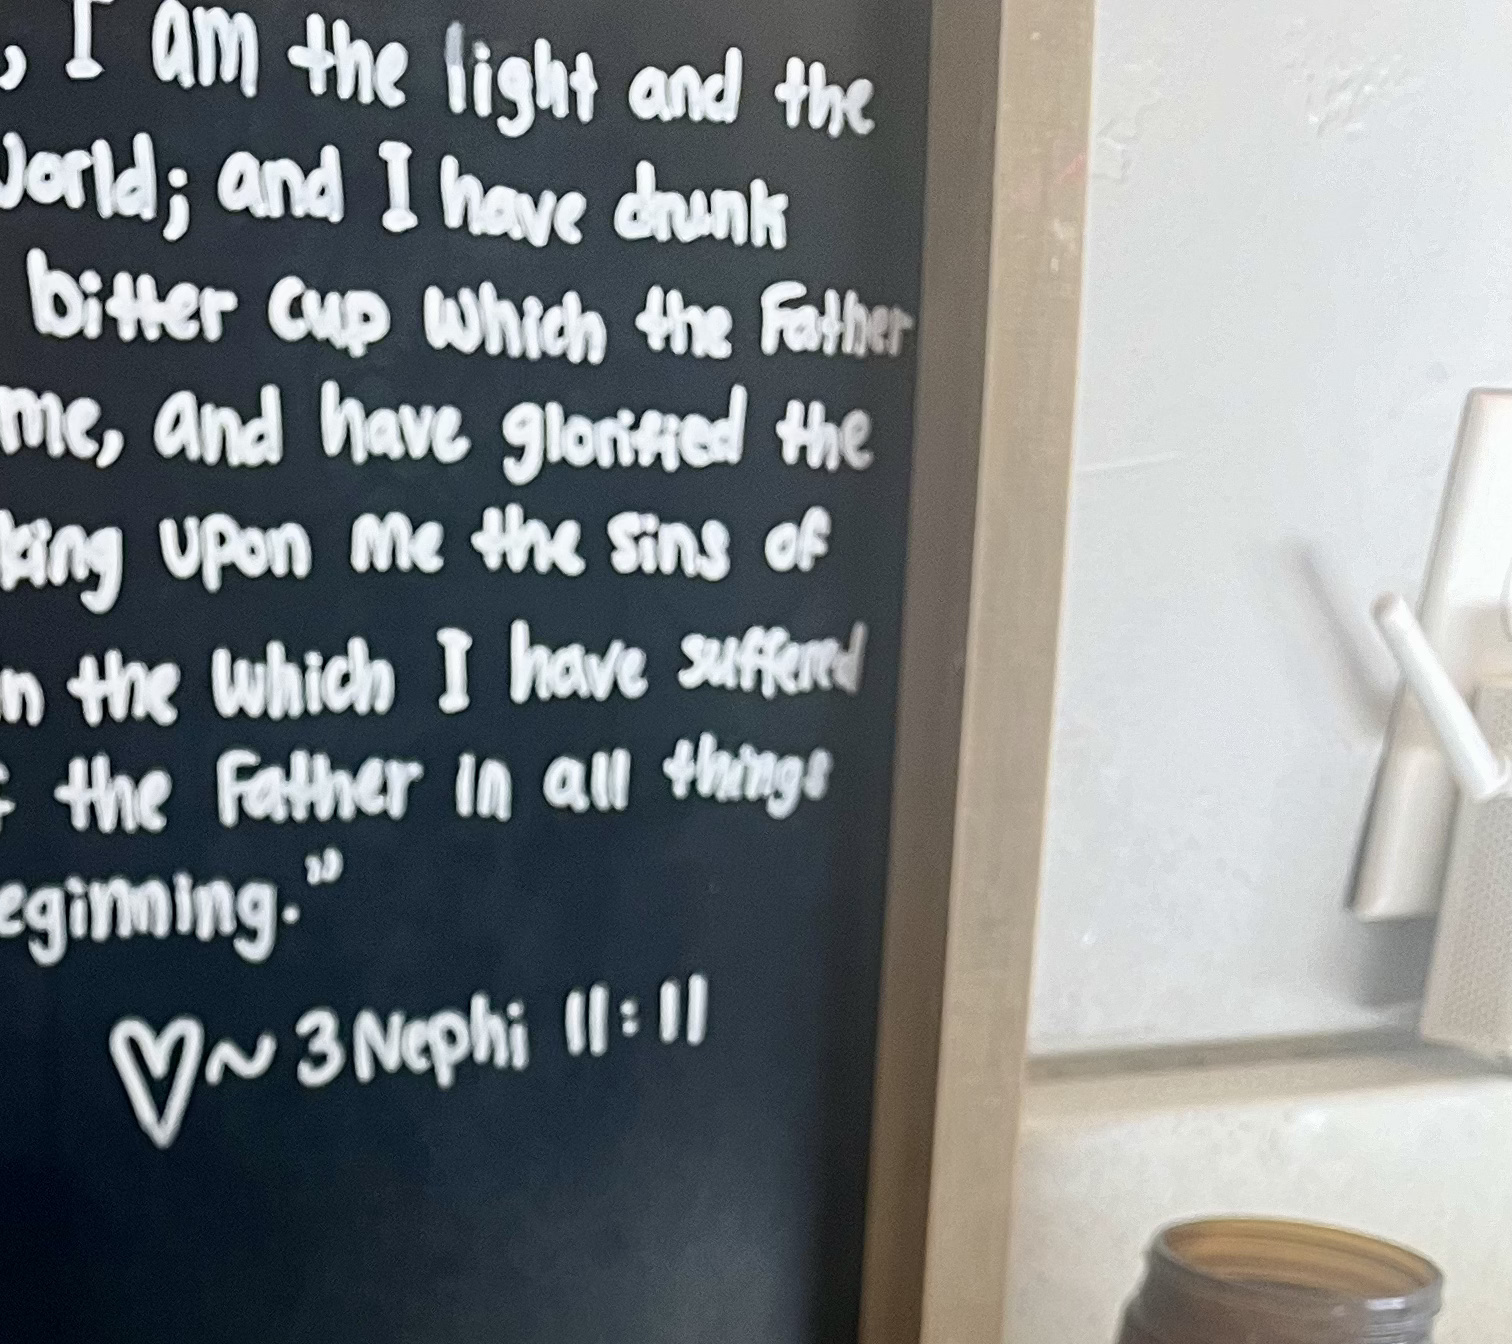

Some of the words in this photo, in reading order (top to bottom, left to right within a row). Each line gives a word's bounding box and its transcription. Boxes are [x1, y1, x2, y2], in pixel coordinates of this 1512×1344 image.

[64, 0, 115, 80] I
[150, 0, 260, 99] am
[286, 11, 410, 109] the
[443, 20, 600, 139] light
[627, 45, 744, 125] and
[773, 55, 876, 140] the
[216, 143, 345, 224] and
[377, 139, 420, 234] I
[439, 153, 588, 249] have
[612, 158, 790, 251] drunk
[25, 246, 239, 343] bitter
[633, 284, 734, 361] the
[759, 279, 914, 358] Father
[152, 382, 284, 468] and
[319, 379, 472, 466] have
[501, 382, 749, 487] glorified
[774, 398, 873, 472] the
[469, 501, 587, 578] the
[763, 505, 832, 573] of
[65, 648, 182, 728] the
[435, 626, 474, 715] I
[509, 618, 650, 705] have
[676, 620, 869, 700] suffered
[53, 754, 173, 834] the
[215, 748, 425, 828] Father
[454, 752, 513, 822] in
[542, 747, 632, 813] all
[661, 730, 835, 820] things
[294, 1009, 345, 1087] 3
[352, 992, 530, 1088] Nephi
[564, 973, 709, 1056] 11:11
